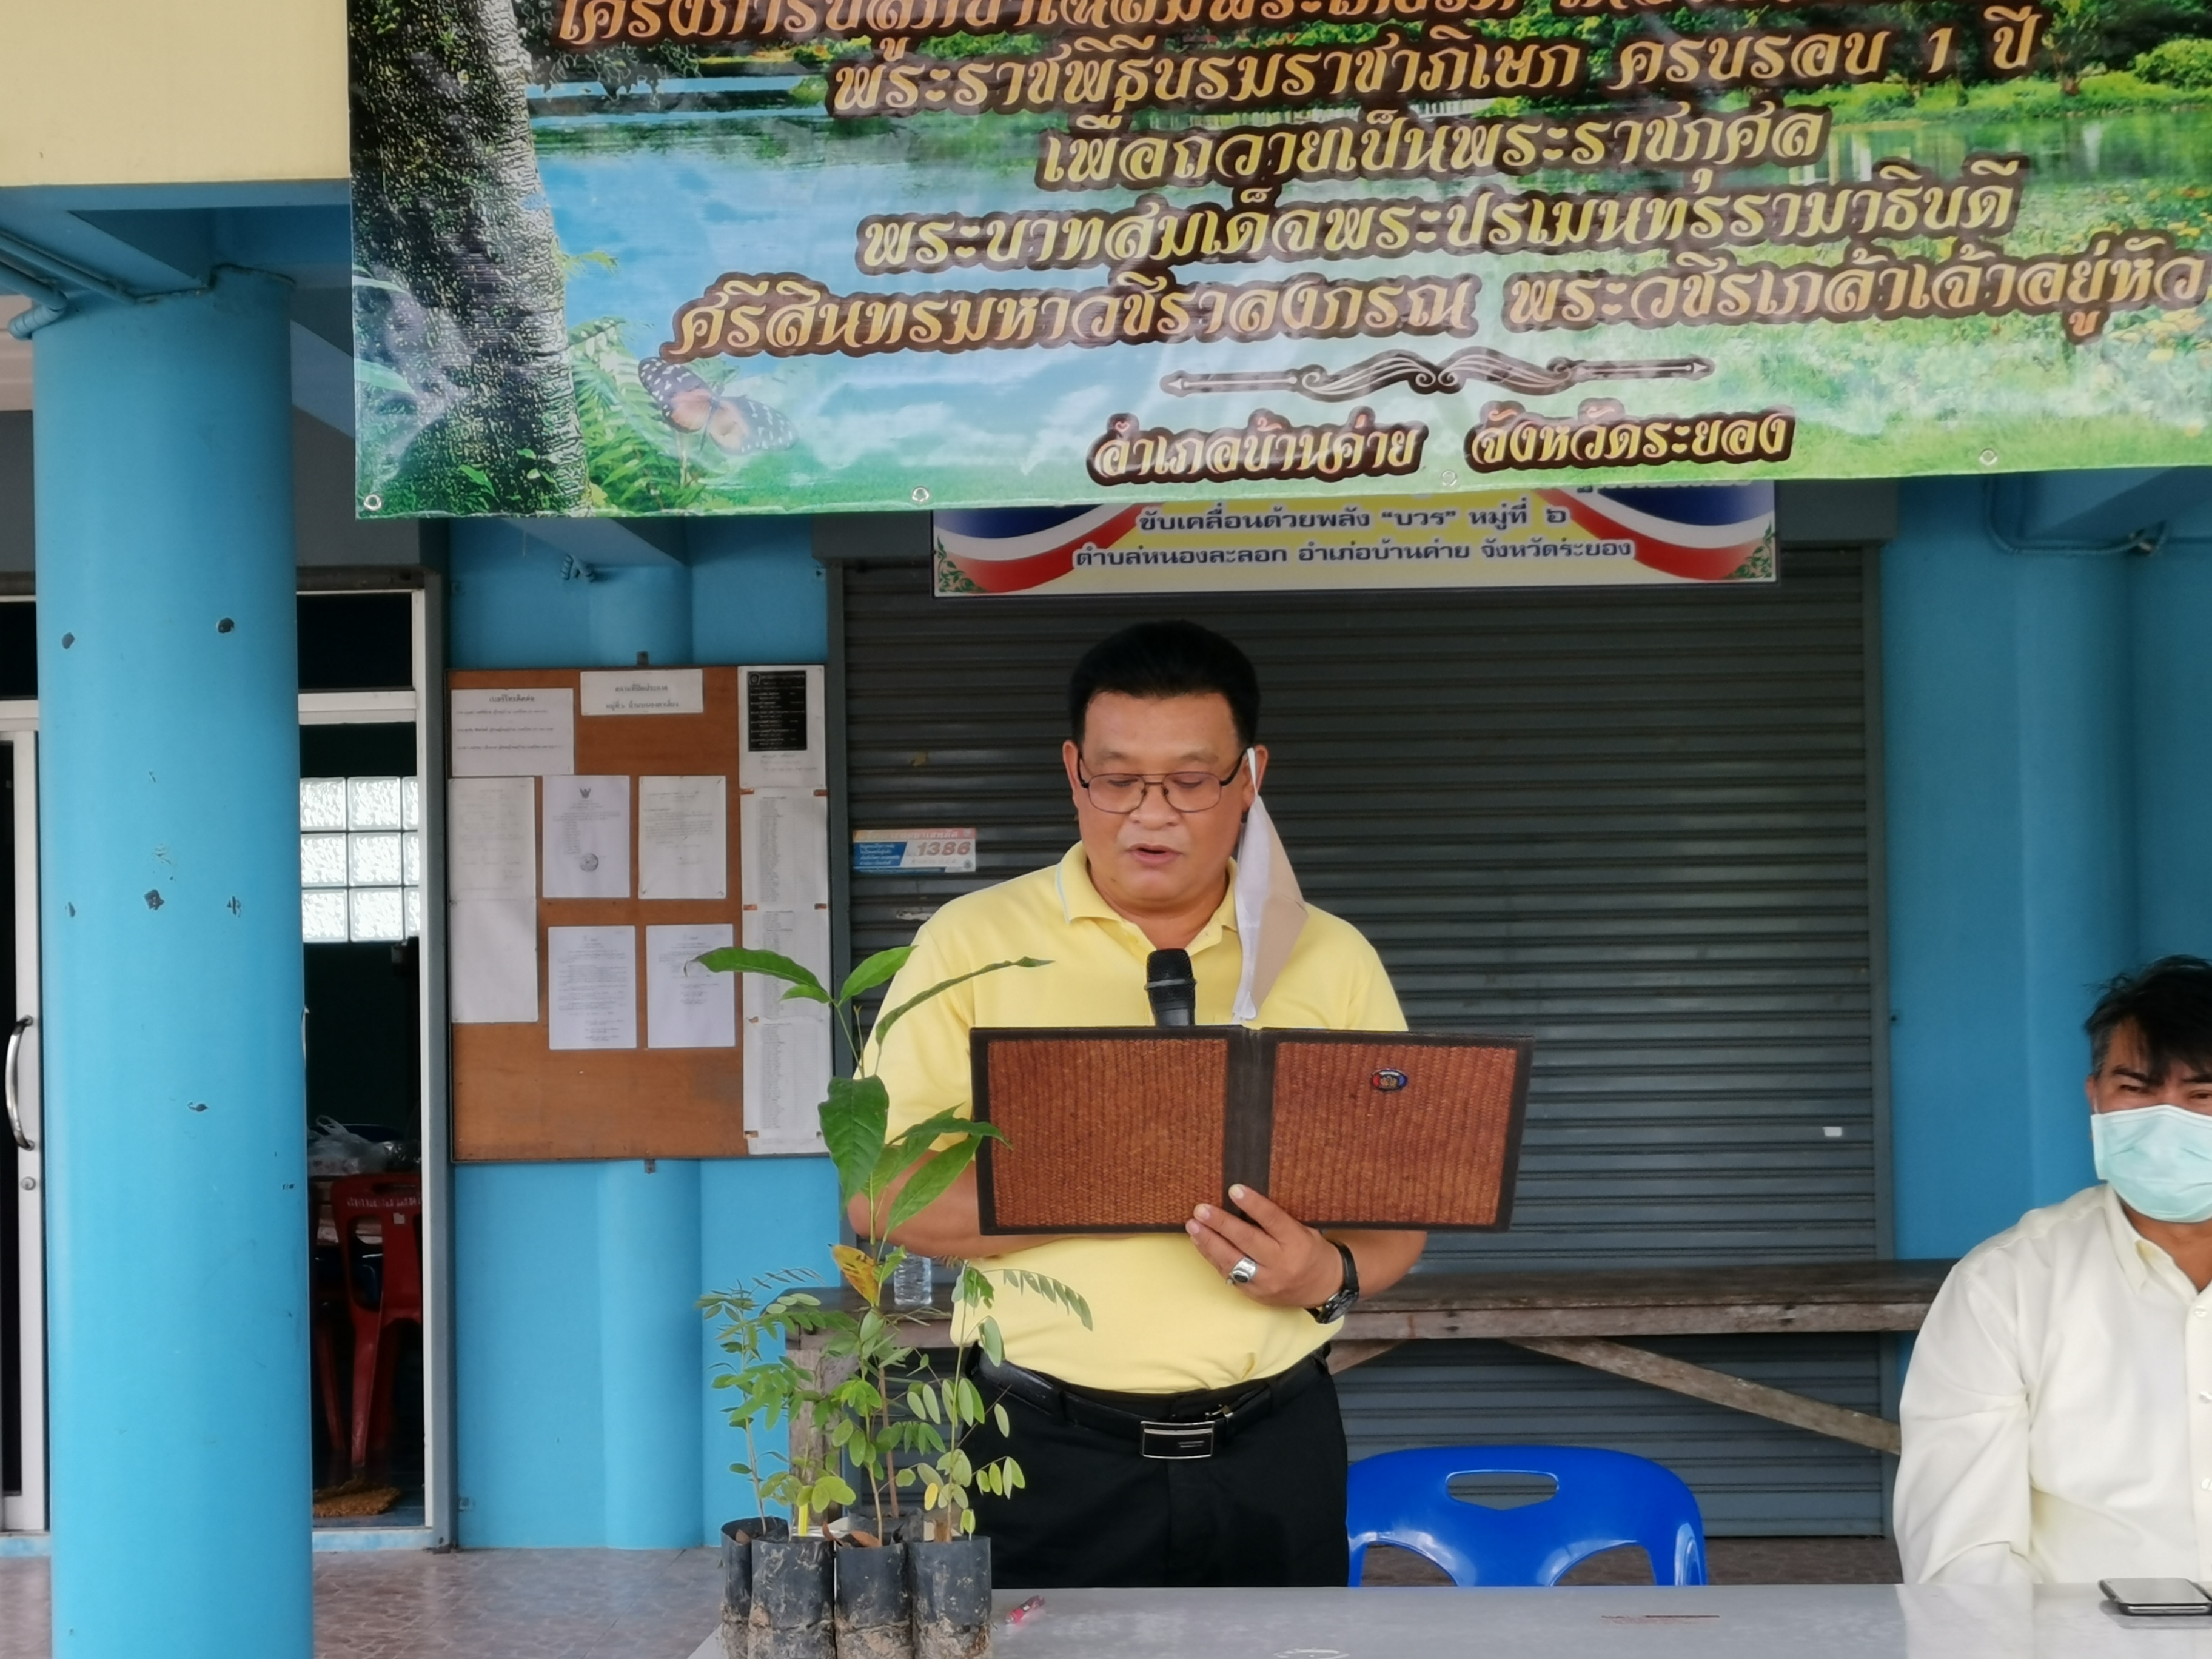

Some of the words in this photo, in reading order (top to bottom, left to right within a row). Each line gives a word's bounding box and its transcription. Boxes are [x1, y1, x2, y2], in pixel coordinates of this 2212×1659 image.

[834, 25, 1580, 110] พระราชพิธีบรมราชาภิเษก
[1607, 31, 1892, 90] ครบรอบ
[1983, 5, 2043, 70] ปี
[1045, 102, 1823, 189] เพื่อถวายเป็นพระราชกุศล
[865, 159, 2018, 268] พระบาทสมเด็จพระปรเมนทรรามาธิบดี
[669, 270, 1473, 355] ศรีสินทรมหาวชิราลงกรณ
[1510, 235, 2206, 337] พระวชิรเกล้าเจ้าอยู่หัว
[1094, 413, 1419, 478] อำเภอบ้านค่าย
[1470, 407, 1788, 466] จังหวัดระยอง
[1076, 546, 1287, 565] ตำบลหนองละลอก
[1298, 538, 1470, 561] อำเภอบ้านค่าย
[1481, 537, 1632, 559] จังหวัดระยอง
[1139, 502, 1370, 531] ขับเคลื่อนด้วยพลัง
[1467, 497, 1528, 531] หมู่ที่
[1546, 507, 1567, 523] ๖
[918, 841, 971, 856] 1386
